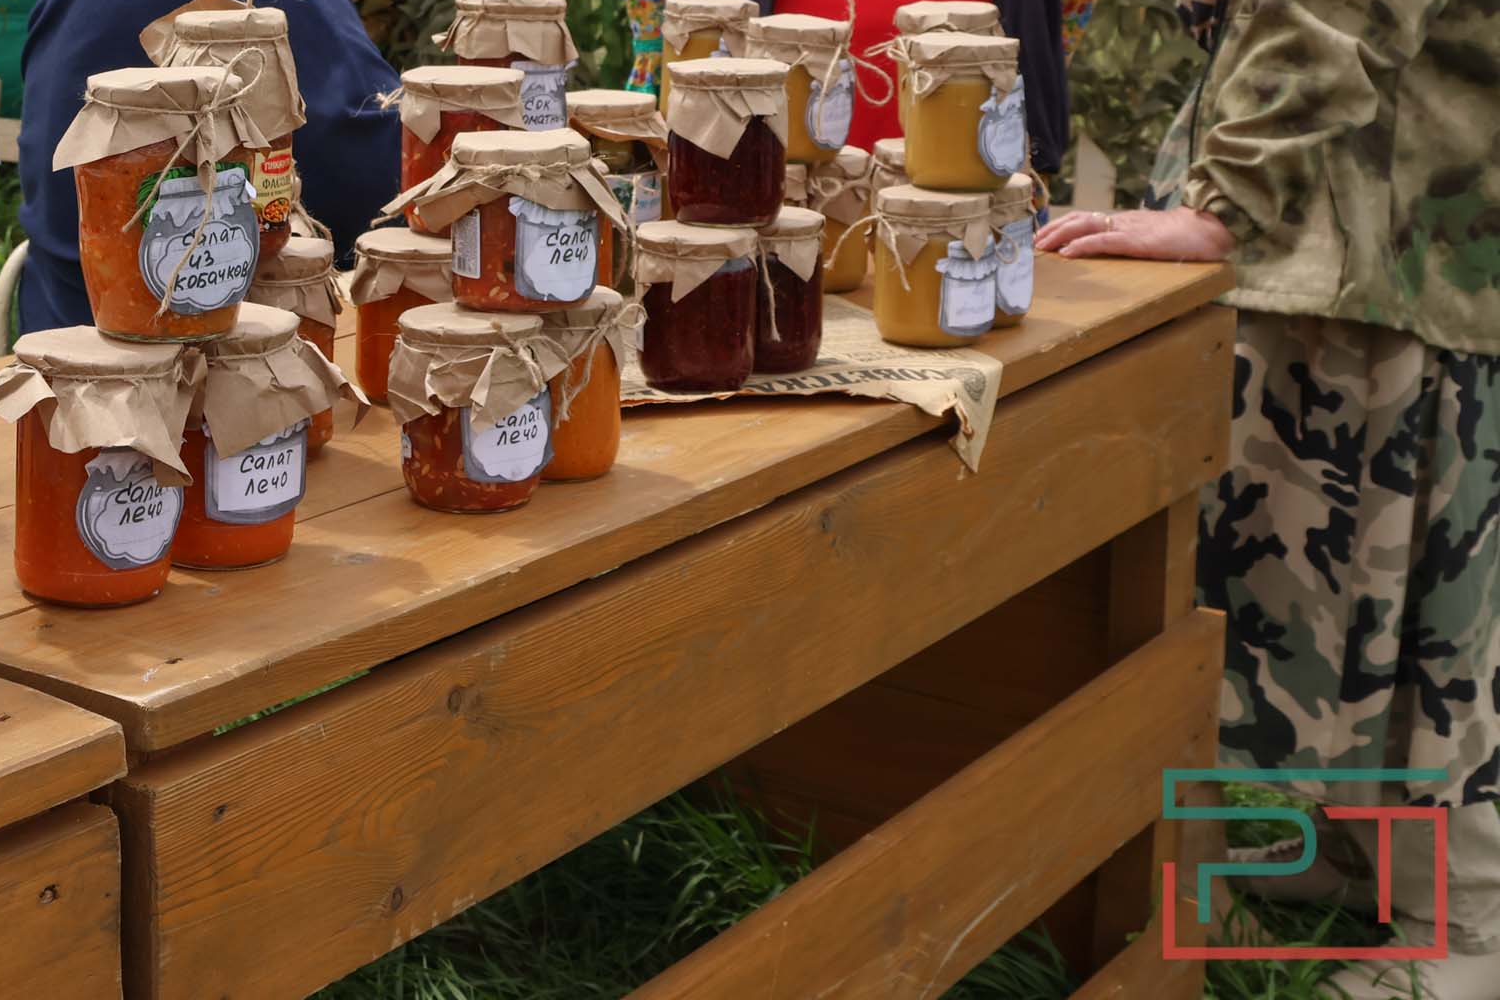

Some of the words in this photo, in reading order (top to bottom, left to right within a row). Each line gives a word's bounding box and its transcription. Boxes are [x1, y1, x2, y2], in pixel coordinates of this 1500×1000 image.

[240, 449, 293, 474] Салат
[244, 471, 288, 497] лечо
[119, 501, 163, 525] лечо
